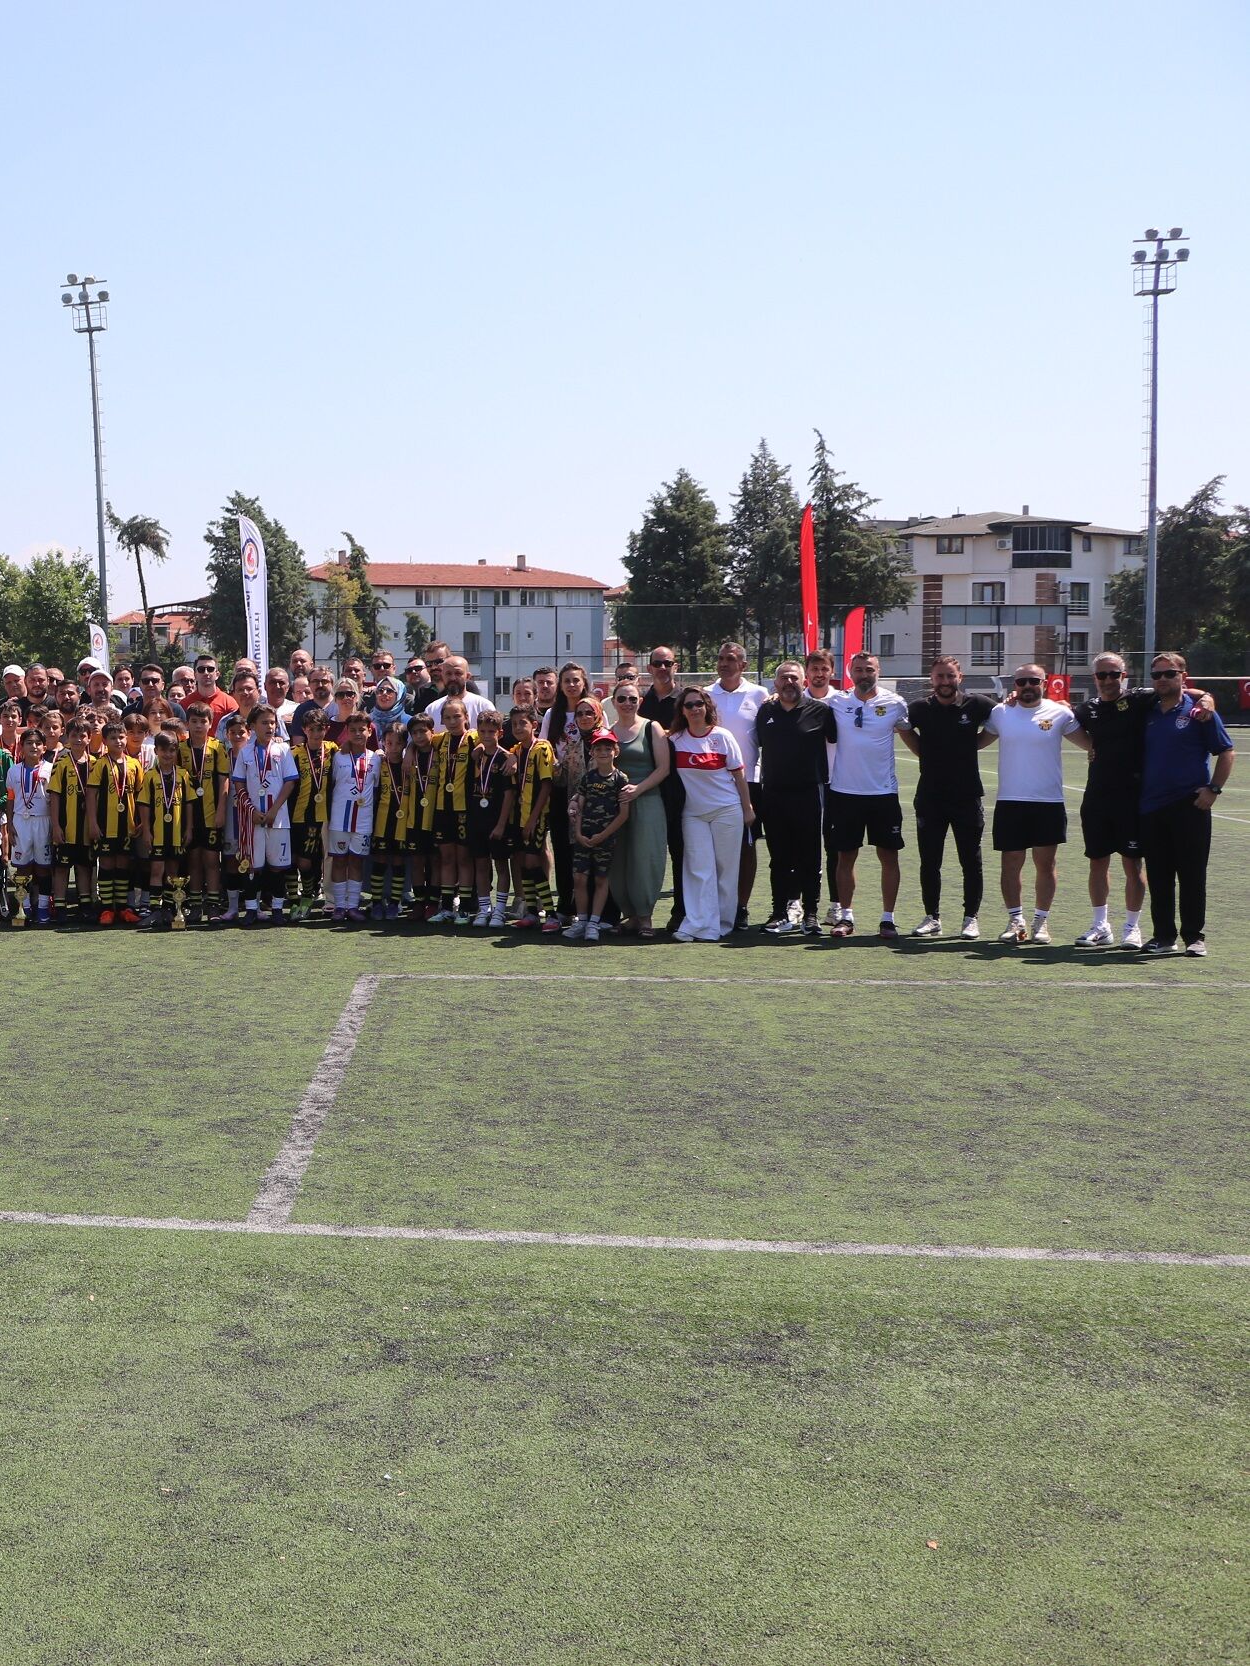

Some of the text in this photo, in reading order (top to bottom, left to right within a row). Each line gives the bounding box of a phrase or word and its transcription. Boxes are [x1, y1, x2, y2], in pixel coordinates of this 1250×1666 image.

[209, 831, 217, 845] 5
[458, 825, 466, 840] 3
[123, 837, 131, 850] 2
[281, 843, 286, 856] 7
